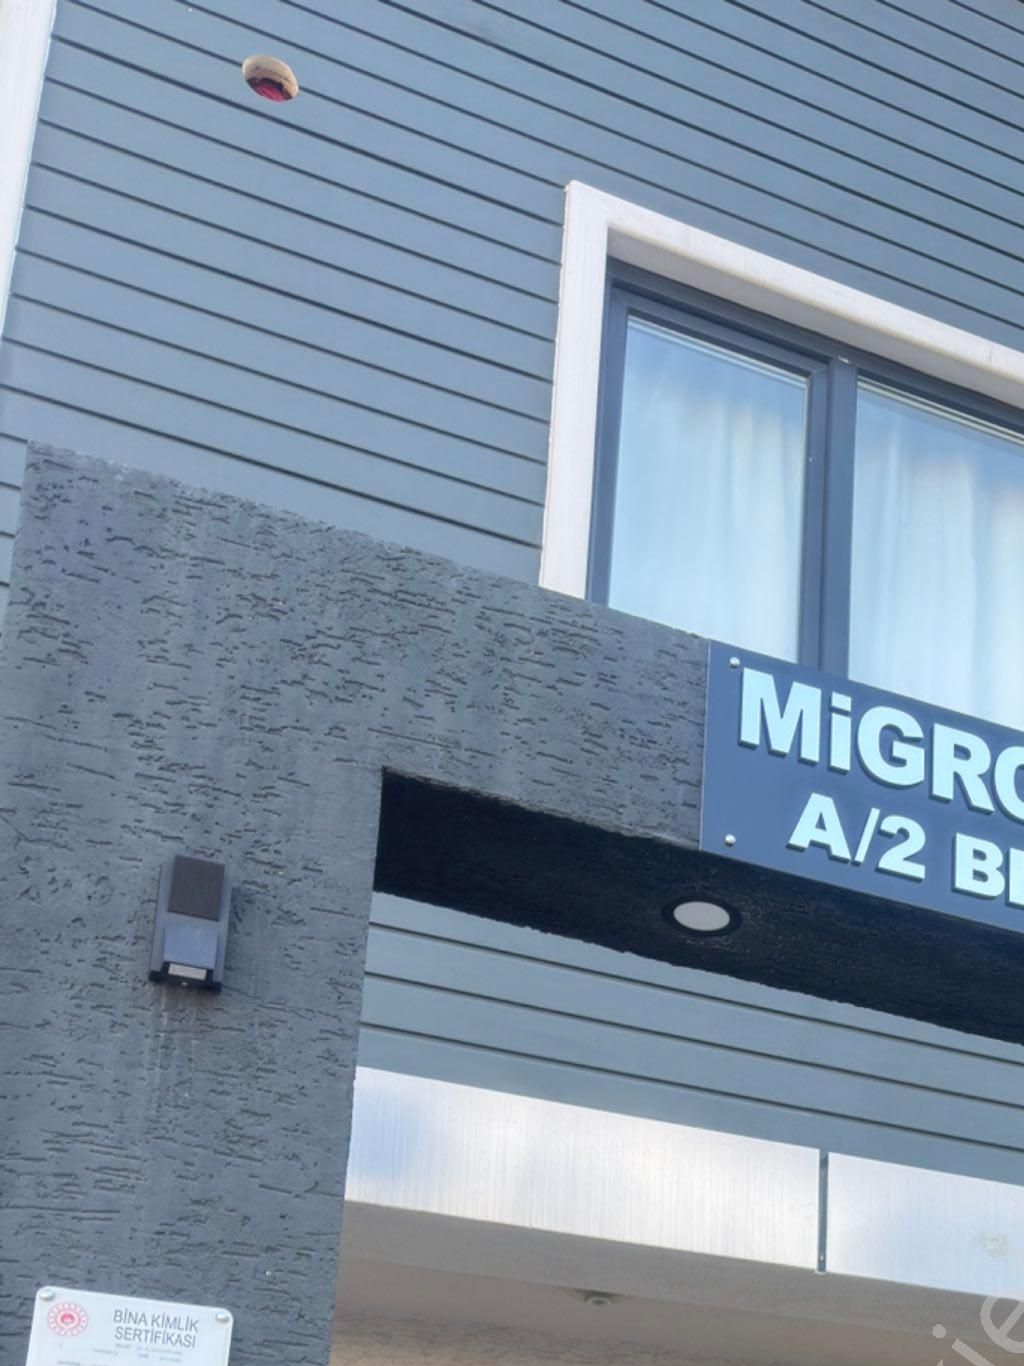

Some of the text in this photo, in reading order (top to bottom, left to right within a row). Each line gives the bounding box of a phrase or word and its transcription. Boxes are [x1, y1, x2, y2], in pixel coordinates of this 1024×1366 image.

[787, 793, 927, 881] A/2
[113, 1308, 200, 1333] BİNA KİMLİK
[114, 1326, 196, 1348] SERTİFİKASI
